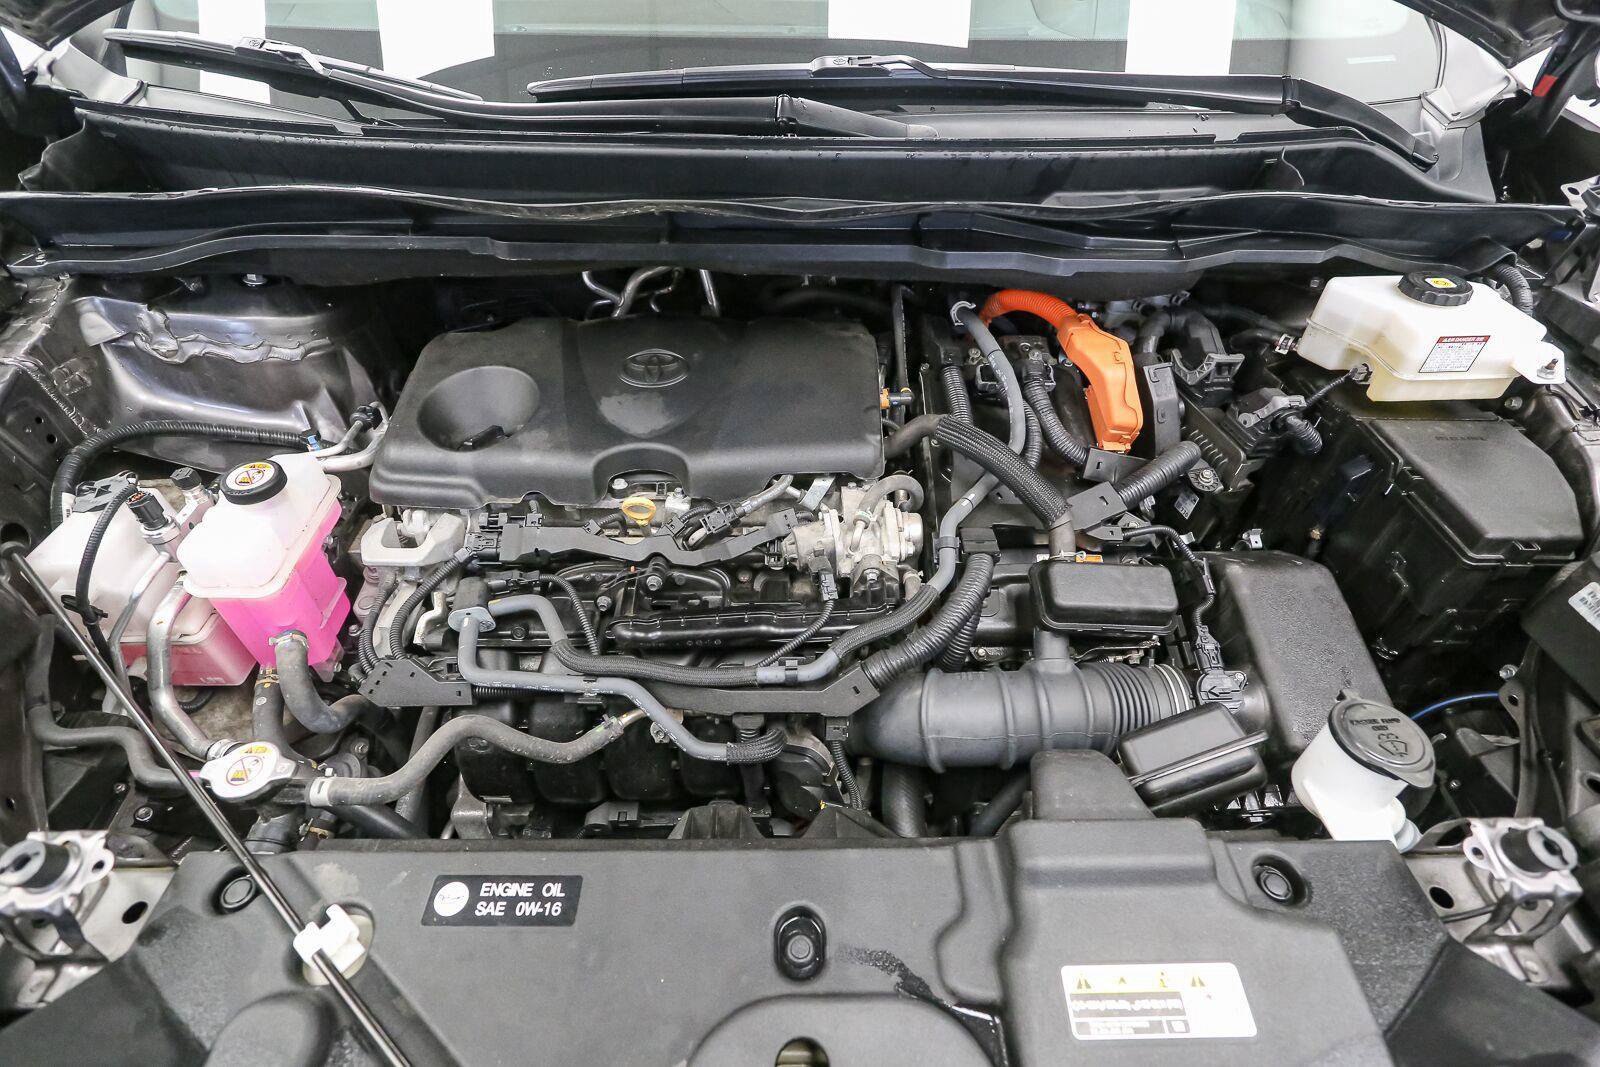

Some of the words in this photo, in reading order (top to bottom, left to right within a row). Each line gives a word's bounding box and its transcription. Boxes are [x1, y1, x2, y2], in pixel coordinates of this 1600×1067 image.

[479, 882, 535, 897] ENGINE
[541, 882, 566, 897] OIL
[474, 901, 507, 917] SAE
[515, 901, 563, 917] 0W-16
